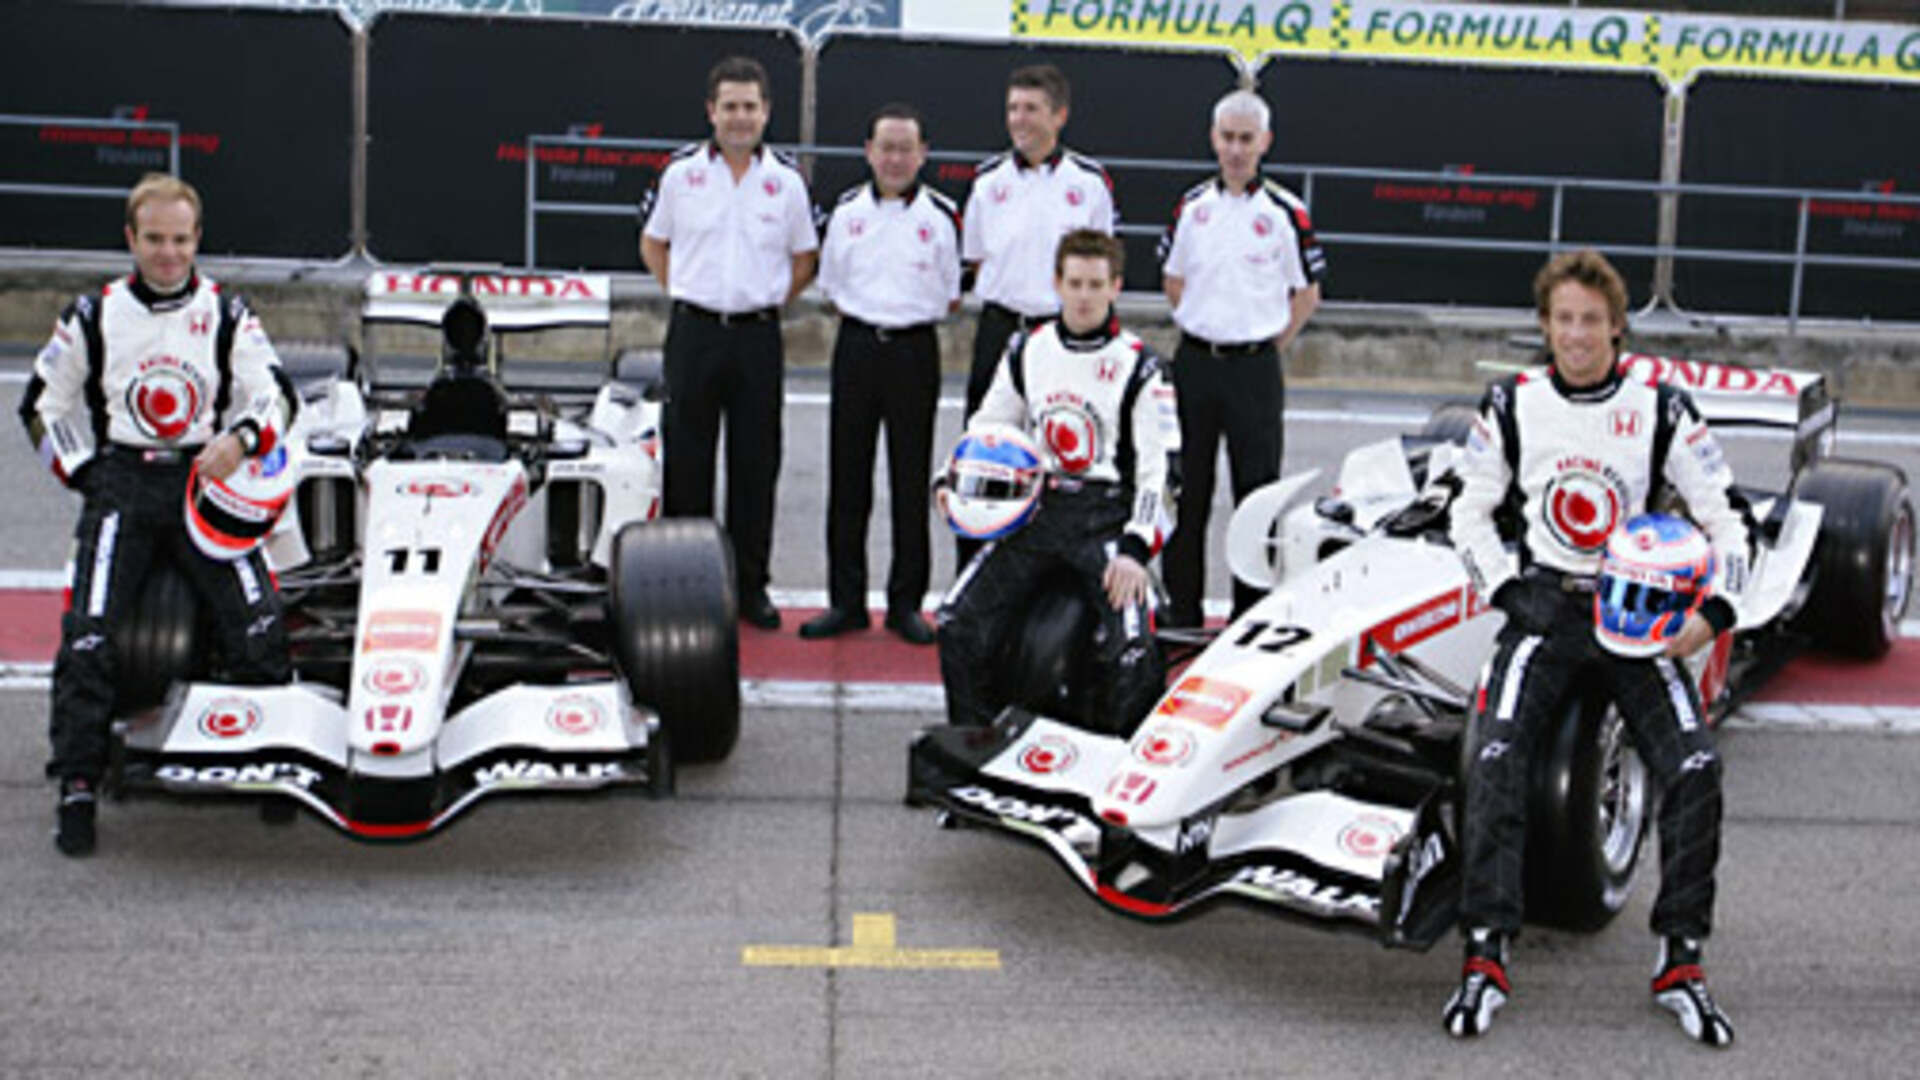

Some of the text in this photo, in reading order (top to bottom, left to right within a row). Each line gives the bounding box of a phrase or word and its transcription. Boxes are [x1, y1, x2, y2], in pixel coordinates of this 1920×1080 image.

[1044, 0, 1313, 45] FORMULA Q
[1365, 9, 1630, 59] FORMULA Q
[1674, 26, 1880, 67] FORMULA
[386, 274, 596, 298] HONDA
[1615, 352, 1798, 396] ONDA
[384, 547, 443, 575] 11
[1233, 621, 1313, 654] 12
